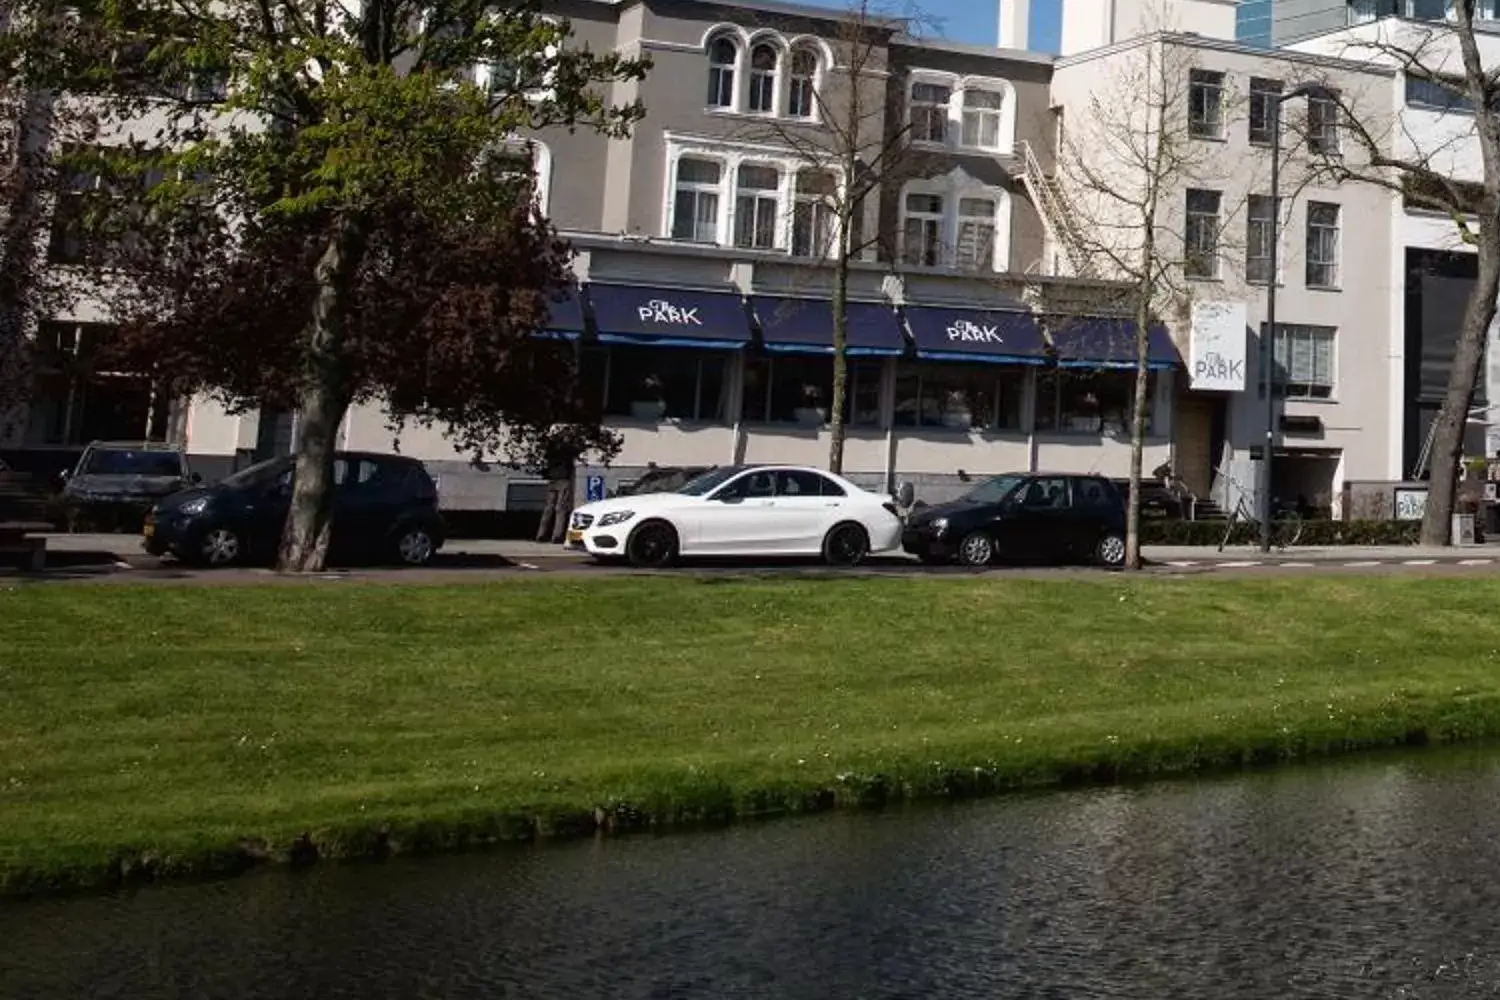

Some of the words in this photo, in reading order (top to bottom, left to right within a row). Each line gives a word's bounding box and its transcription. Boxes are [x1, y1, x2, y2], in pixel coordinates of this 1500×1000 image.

[639, 306, 703, 326] PARK
[947, 325, 1003, 343] PARK
[1195, 359, 1243, 380] PARK
